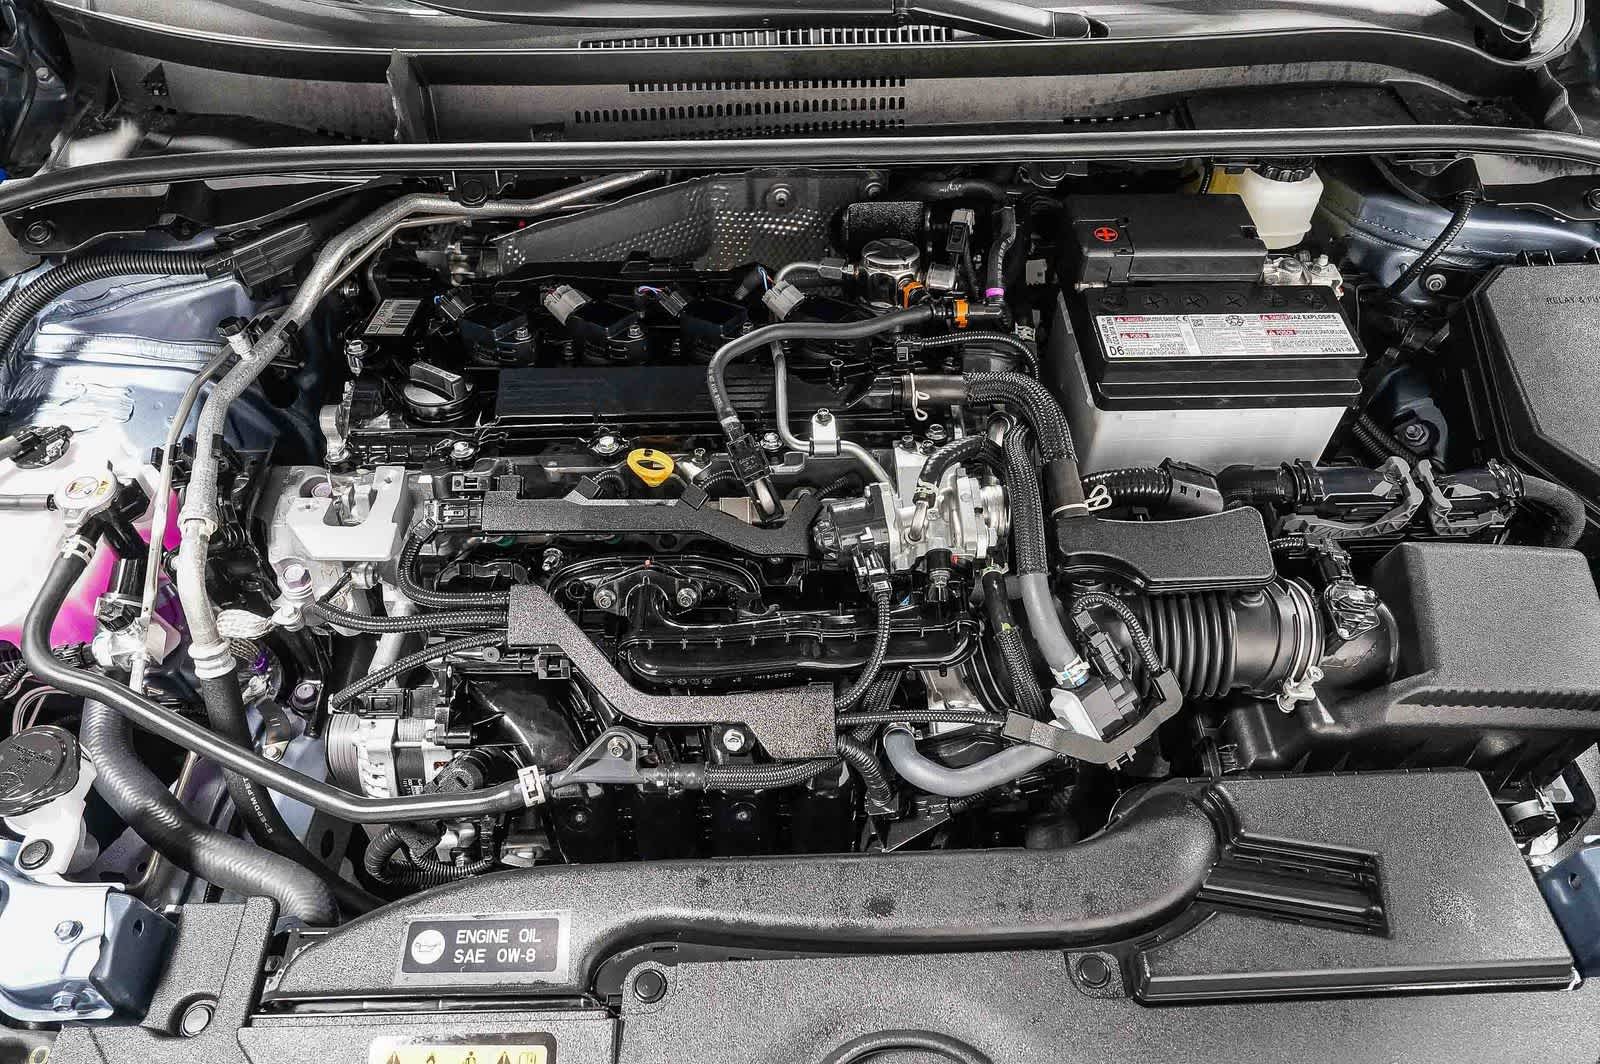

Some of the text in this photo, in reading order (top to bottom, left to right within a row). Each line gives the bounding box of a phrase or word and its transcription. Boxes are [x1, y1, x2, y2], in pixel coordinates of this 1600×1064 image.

[1109, 346, 1125, 356] D6
[455, 928, 542, 944] ENGINE OIL
[453, 948, 487, 964] SAE
